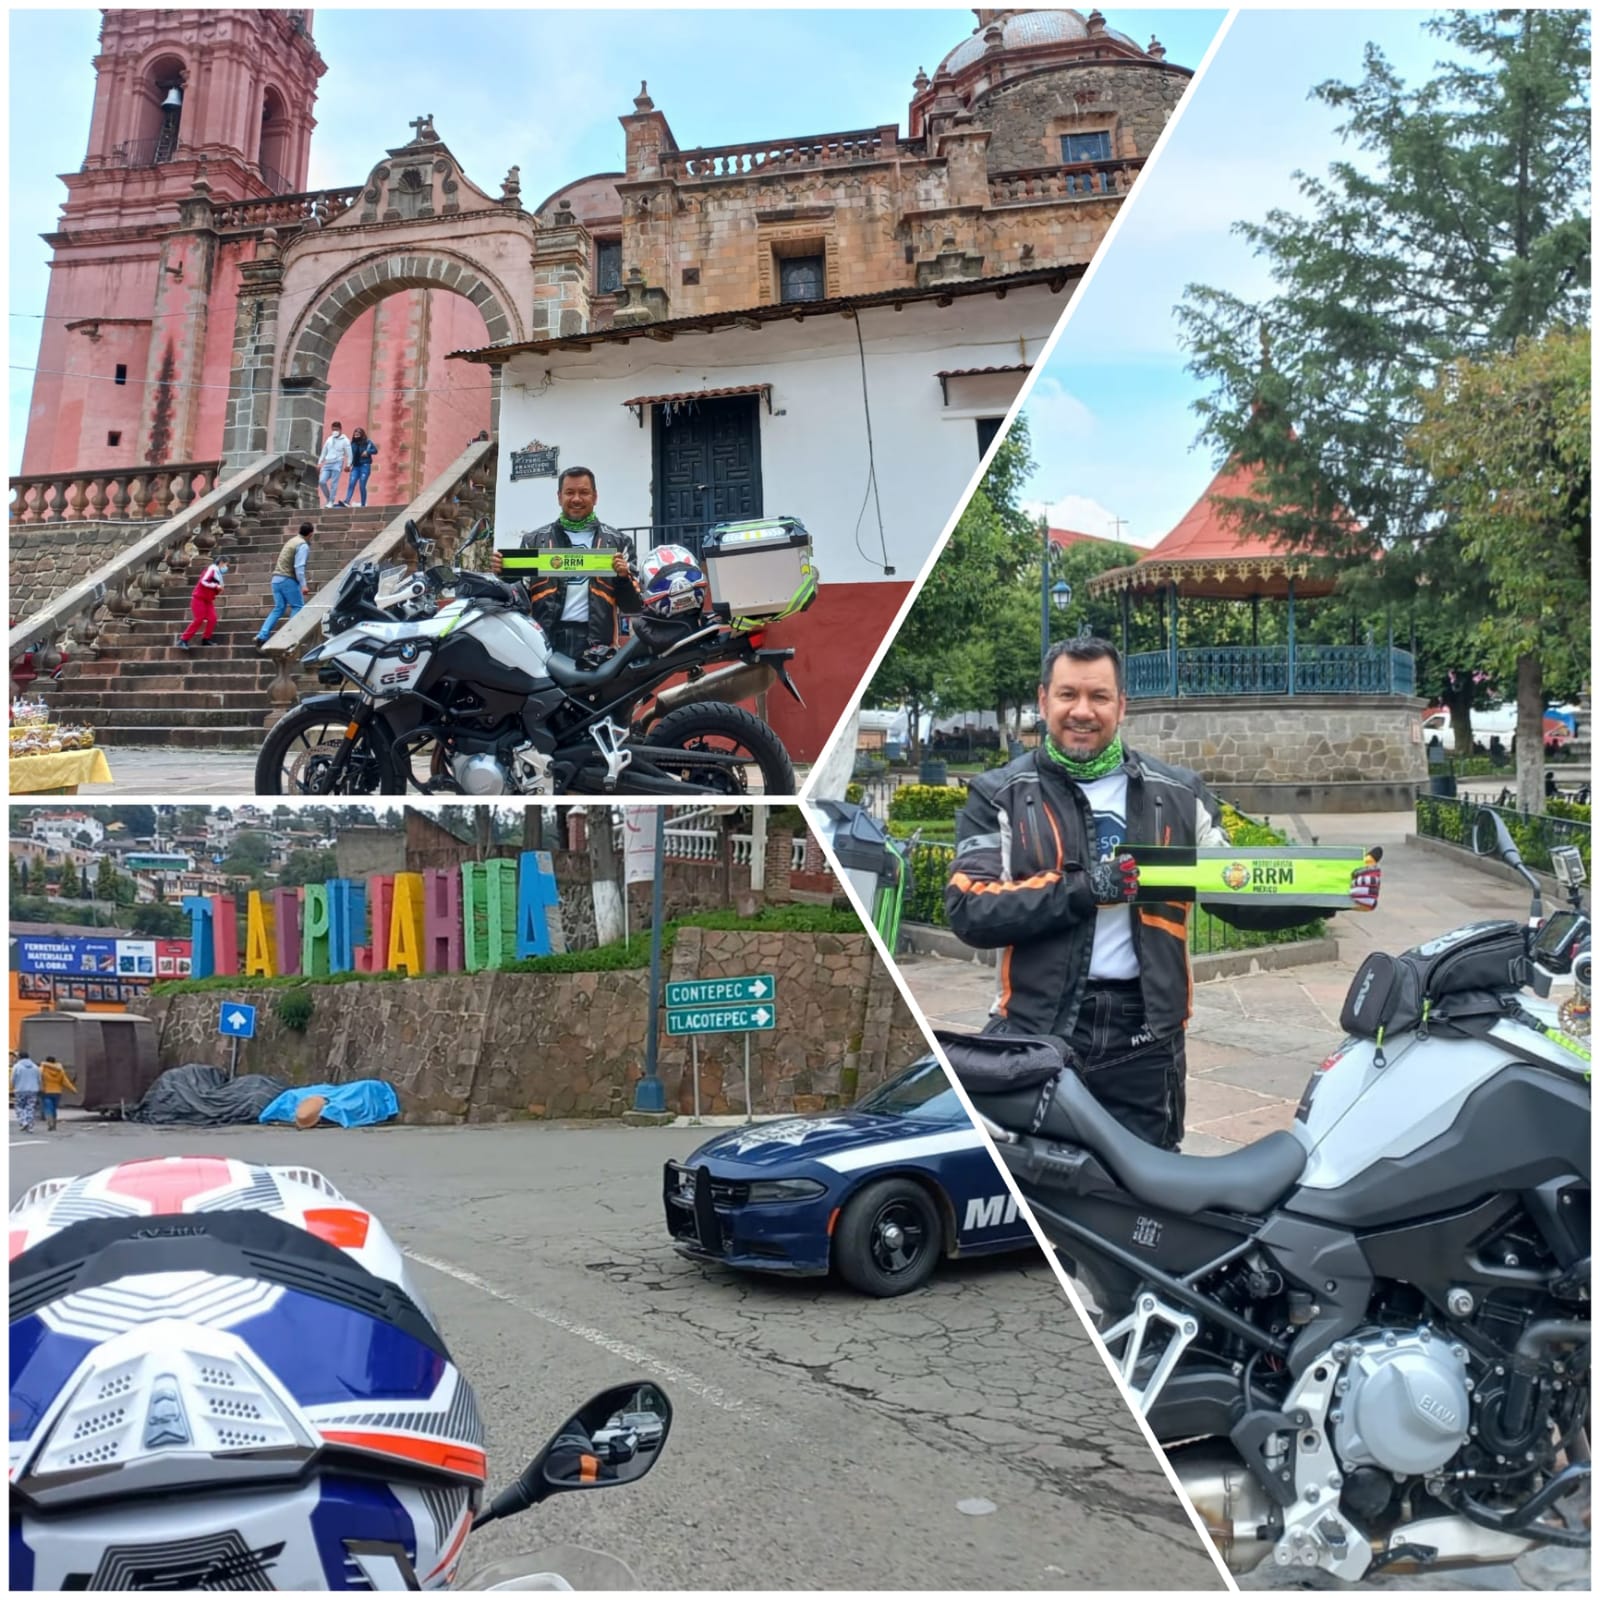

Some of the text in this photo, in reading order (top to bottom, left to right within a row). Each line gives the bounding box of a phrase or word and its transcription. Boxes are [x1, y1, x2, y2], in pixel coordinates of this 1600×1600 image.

[563, 558, 584, 567] RRM
[380, 670, 410, 685] GS
[1252, 868, 1293, 885] RRM
[24, 942, 70, 952] FERRETERÍA
[70, 944, 76, 952] Y
[27, 952, 74, 961] MATERIALES
[34, 961, 68, 970] LA OBRA
[672, 983, 743, 1002] CONTEPEC
[670, 1011, 748, 1030] TLACOTEPEC
[963, 1194, 1025, 1230] MI
[1418, 1393, 1456, 1424] BMW
